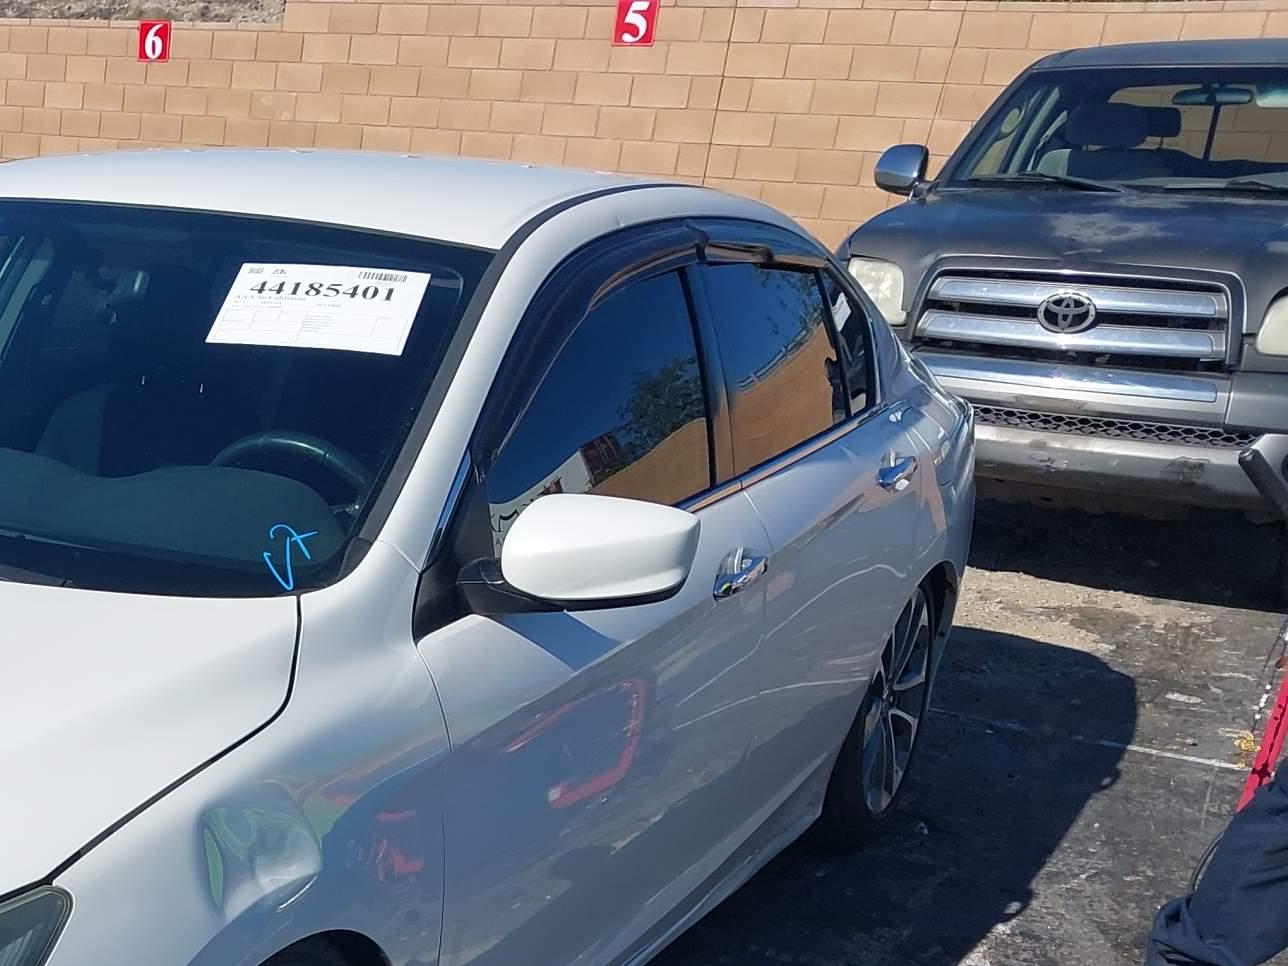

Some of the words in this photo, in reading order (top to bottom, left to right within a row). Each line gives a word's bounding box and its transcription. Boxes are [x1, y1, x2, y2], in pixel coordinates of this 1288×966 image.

[621, 1, 650, 43] 5
[144, 23, 164, 59] 6
[249, 281, 395, 301] 44185401
